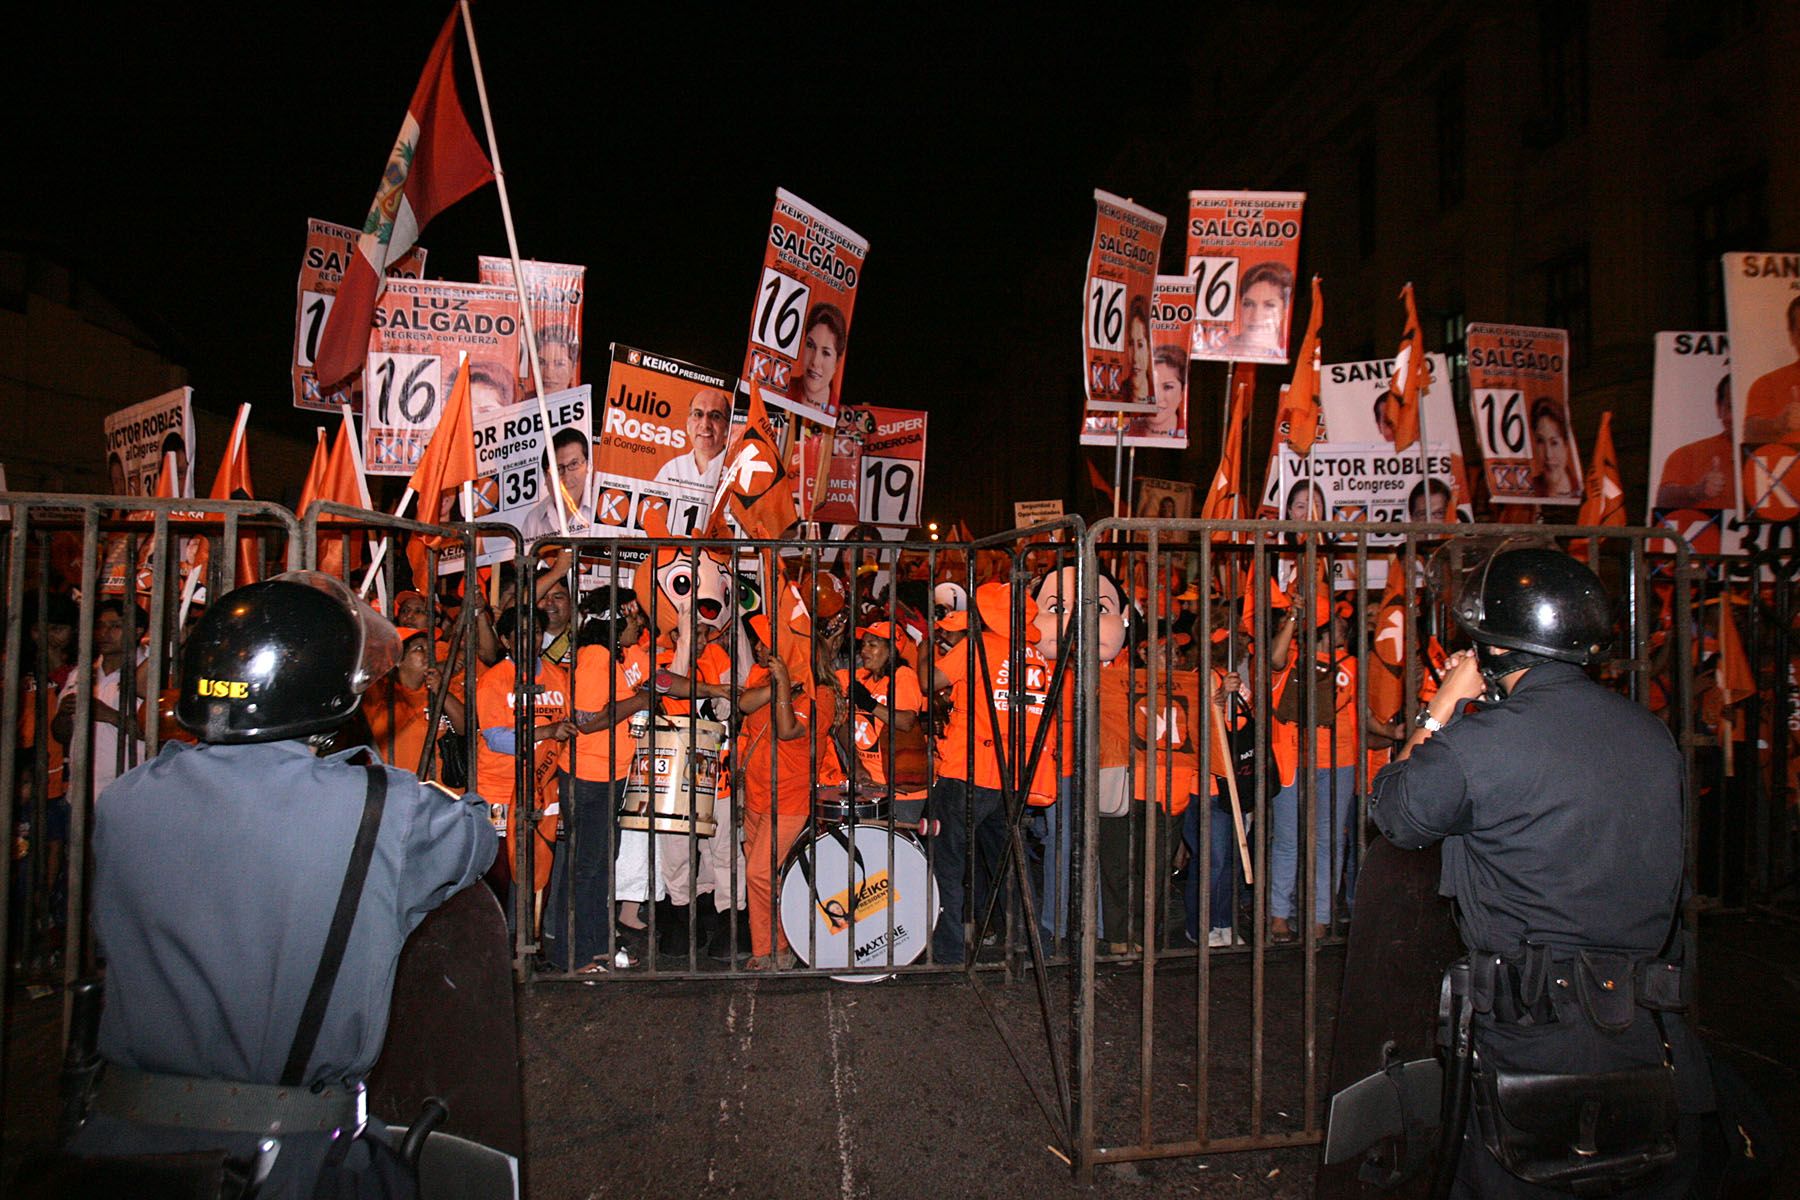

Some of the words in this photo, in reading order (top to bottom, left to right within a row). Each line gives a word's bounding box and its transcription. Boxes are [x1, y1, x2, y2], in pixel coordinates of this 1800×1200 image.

[1227, 208, 1264, 218] LUZ
[806, 228, 836, 253] LUZ
[1120, 224, 1140, 241] LUZ
[1192, 220, 1298, 238] SALGADO
[771, 225, 856, 288] SALGADO
[1099, 234, 1155, 265] SALGADO
[413, 297, 469, 311] LUZ
[1193, 261, 1235, 318] 16
[371, 307, 516, 336] SALGADO
[758, 276, 806, 349] 16
[1093, 285, 1123, 344] 16
[384, 331, 433, 341] REGRESA
[436, 335, 455, 343] con
[458, 336, 498, 345] FUERZA
[1499, 337, 1534, 349] LUZ
[642, 355, 679, 375] KEIKO
[678, 369, 725, 387] PRESIDENTE
[1472, 348, 1563, 372] SALGADO
[376, 357, 436, 425] 16
[610, 384, 671, 418] Julio
[142, 406, 183, 438] ROBLES
[504, 402, 584, 440] ROBLES
[605, 407, 686, 449] Rosas
[877, 418, 923, 436] SUPER
[1481, 393, 1525, 454] 16
[480, 438, 537, 462] Congreso
[603, 437, 611, 446] al
[613, 437, 656, 455] Congreso
[1289, 458, 1366, 477] VICTOR
[1374, 456, 1451, 475] ROBLES
[506, 468, 537, 505] 35
[866, 461, 914, 521] 19
[1333, 479, 1344, 491] al
[1348, 477, 1405, 493] Congreso
[199, 679, 249, 699] USE
